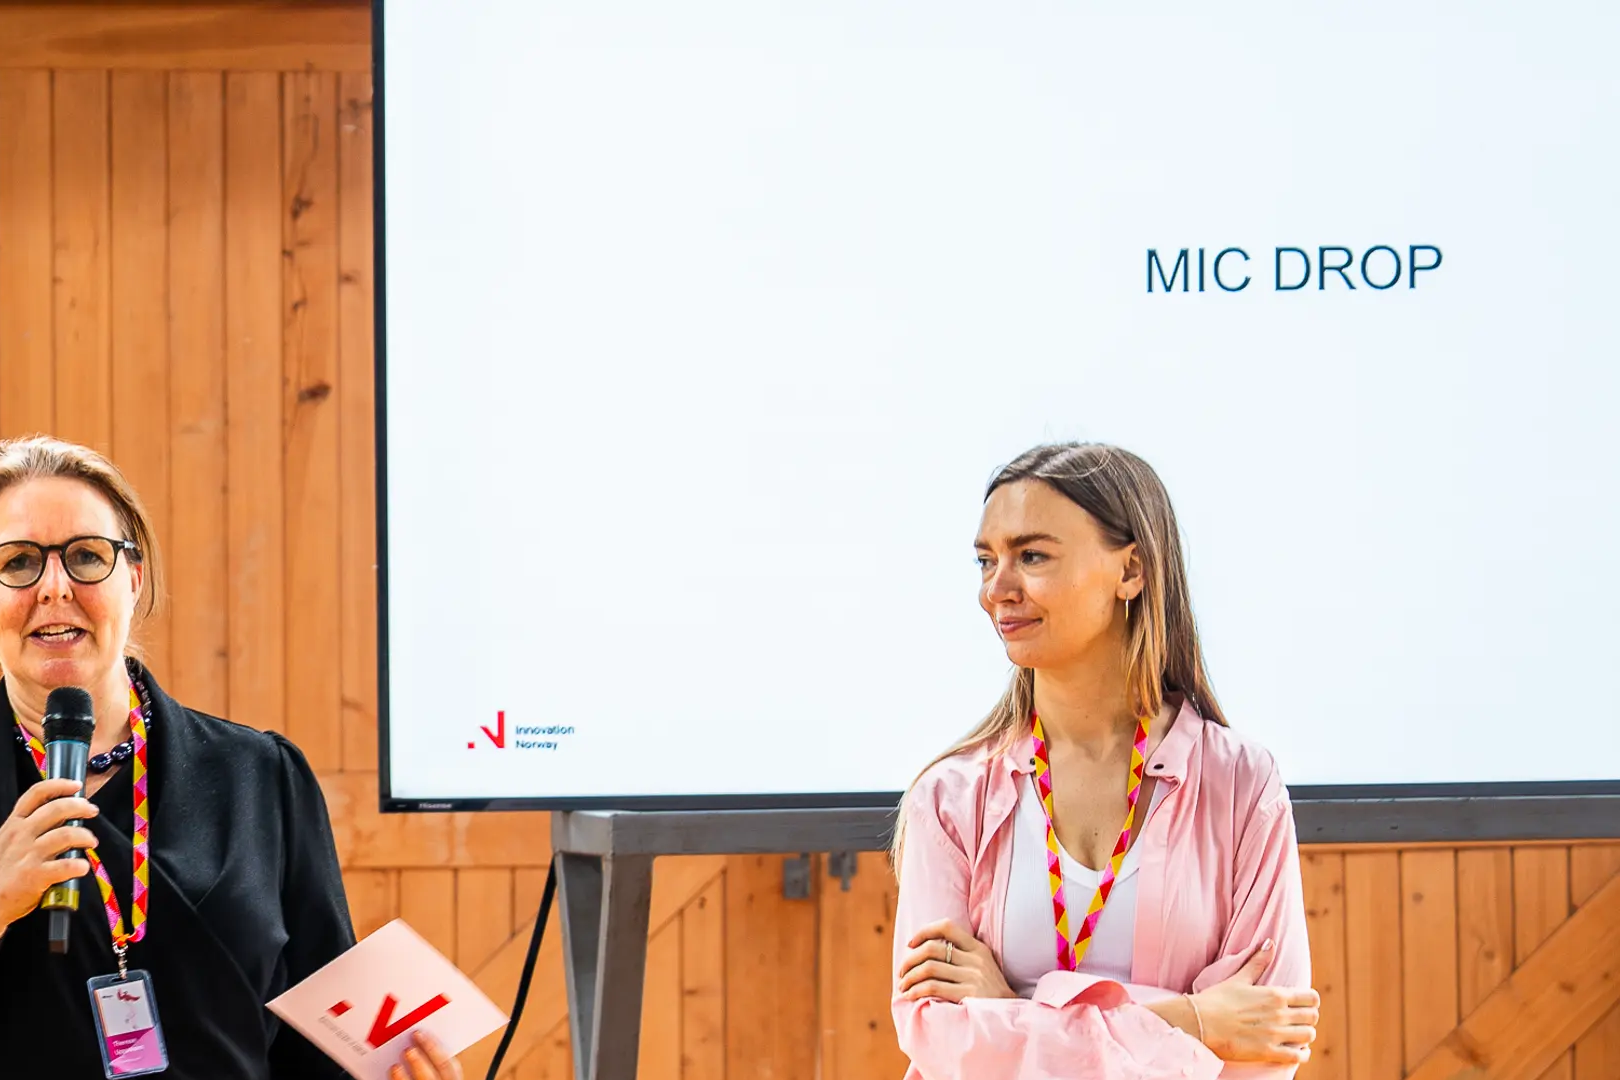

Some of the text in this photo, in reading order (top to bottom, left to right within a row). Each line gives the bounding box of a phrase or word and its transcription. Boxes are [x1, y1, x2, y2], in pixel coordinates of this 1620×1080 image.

[1146, 244, 1444, 293] MIC DROP
[515, 724, 575, 735] Innovation
[515, 740, 558, 751] Norway
